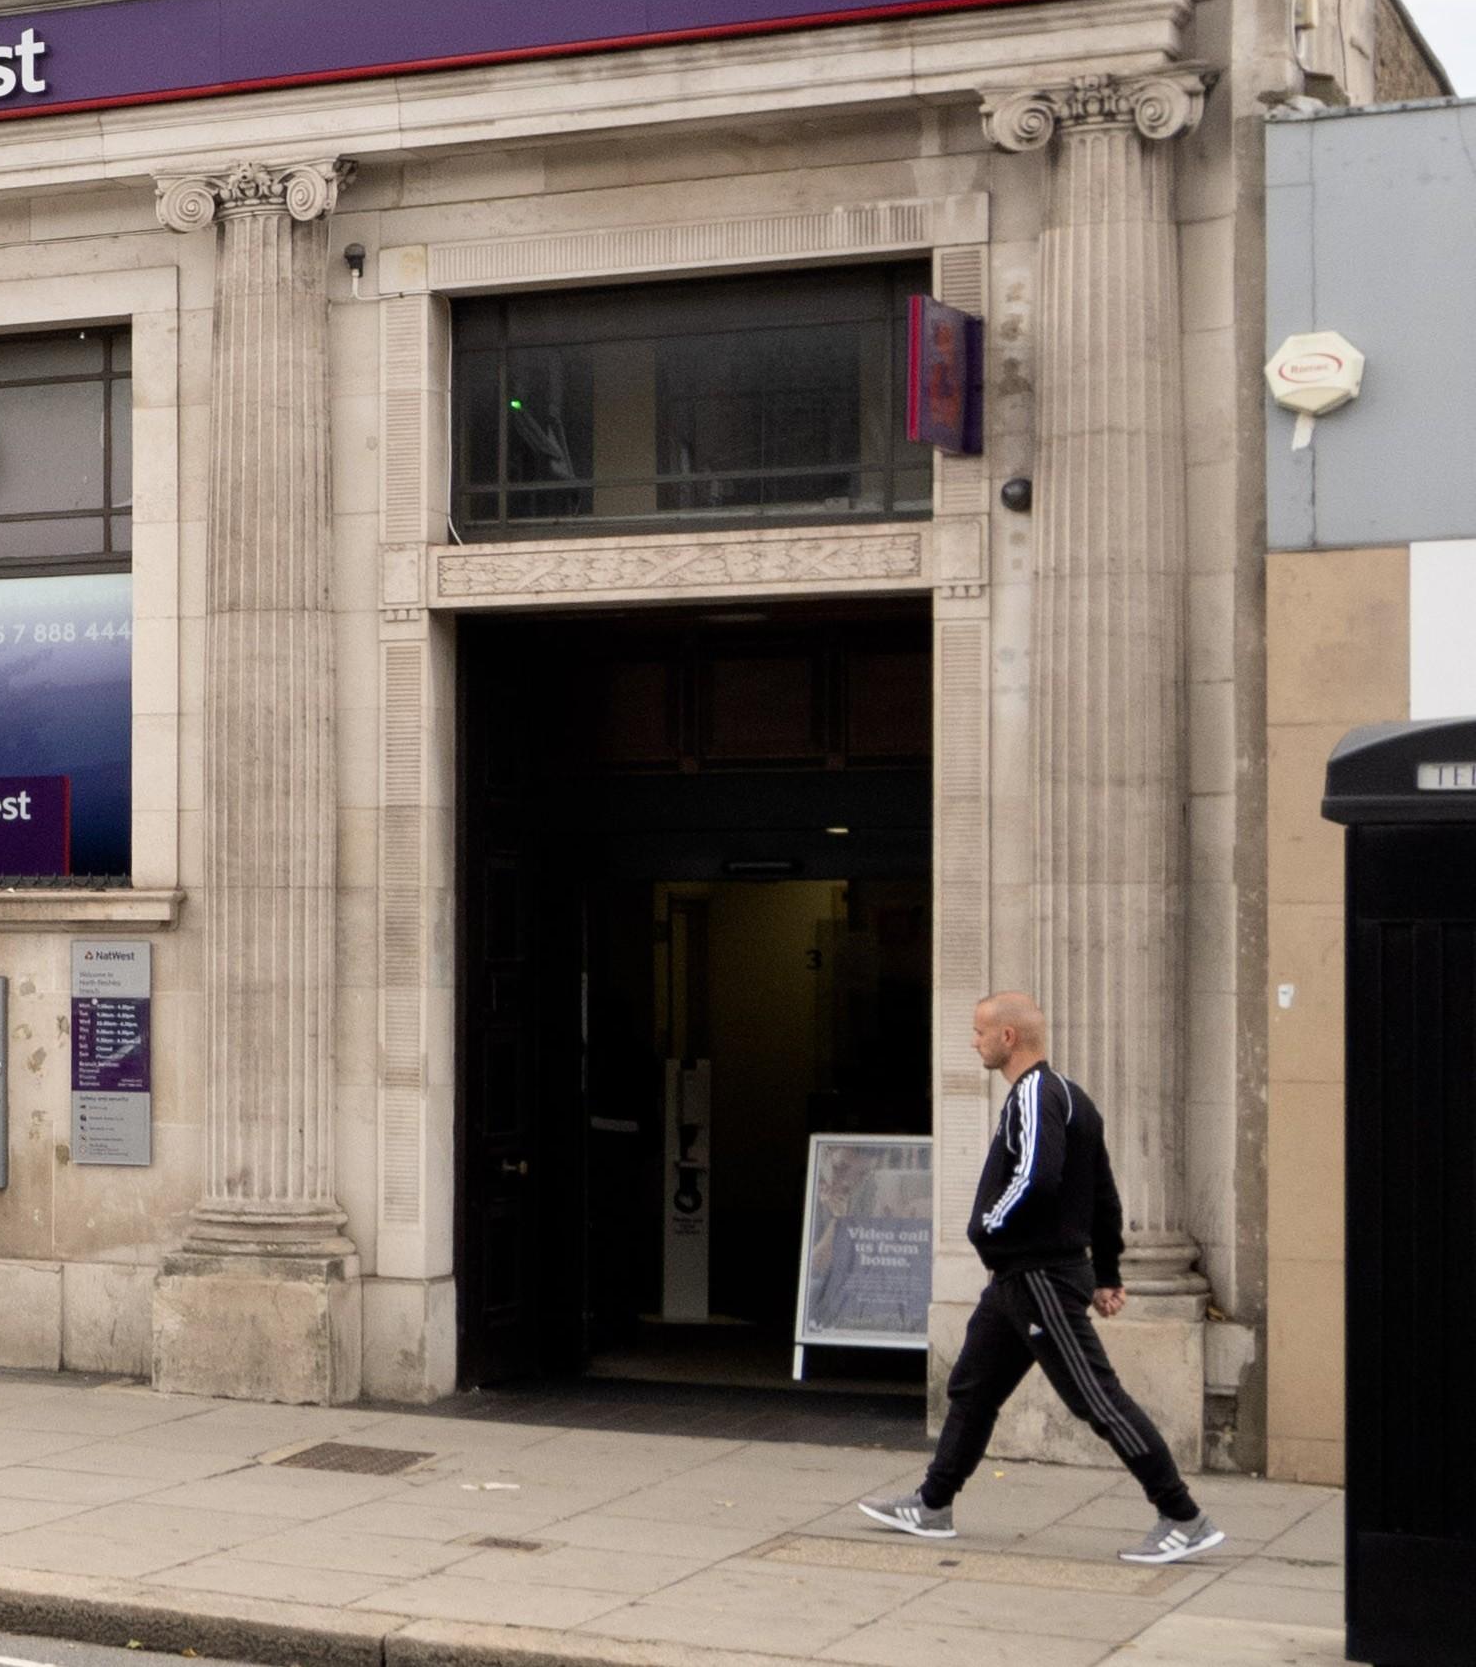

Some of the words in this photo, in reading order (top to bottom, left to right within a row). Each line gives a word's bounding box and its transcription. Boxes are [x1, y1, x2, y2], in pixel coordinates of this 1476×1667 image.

[12, 625, 26, 643] 7
[34, 622, 76, 643] 888
[96, 951, 135, 961] NatWest
[846, 1226, 894, 1240] Video
[899, 1229, 930, 1242] call
[854, 1243, 873, 1252] us
[878, 1241, 918, 1254] from
[860, 1254, 910, 1268] home.
